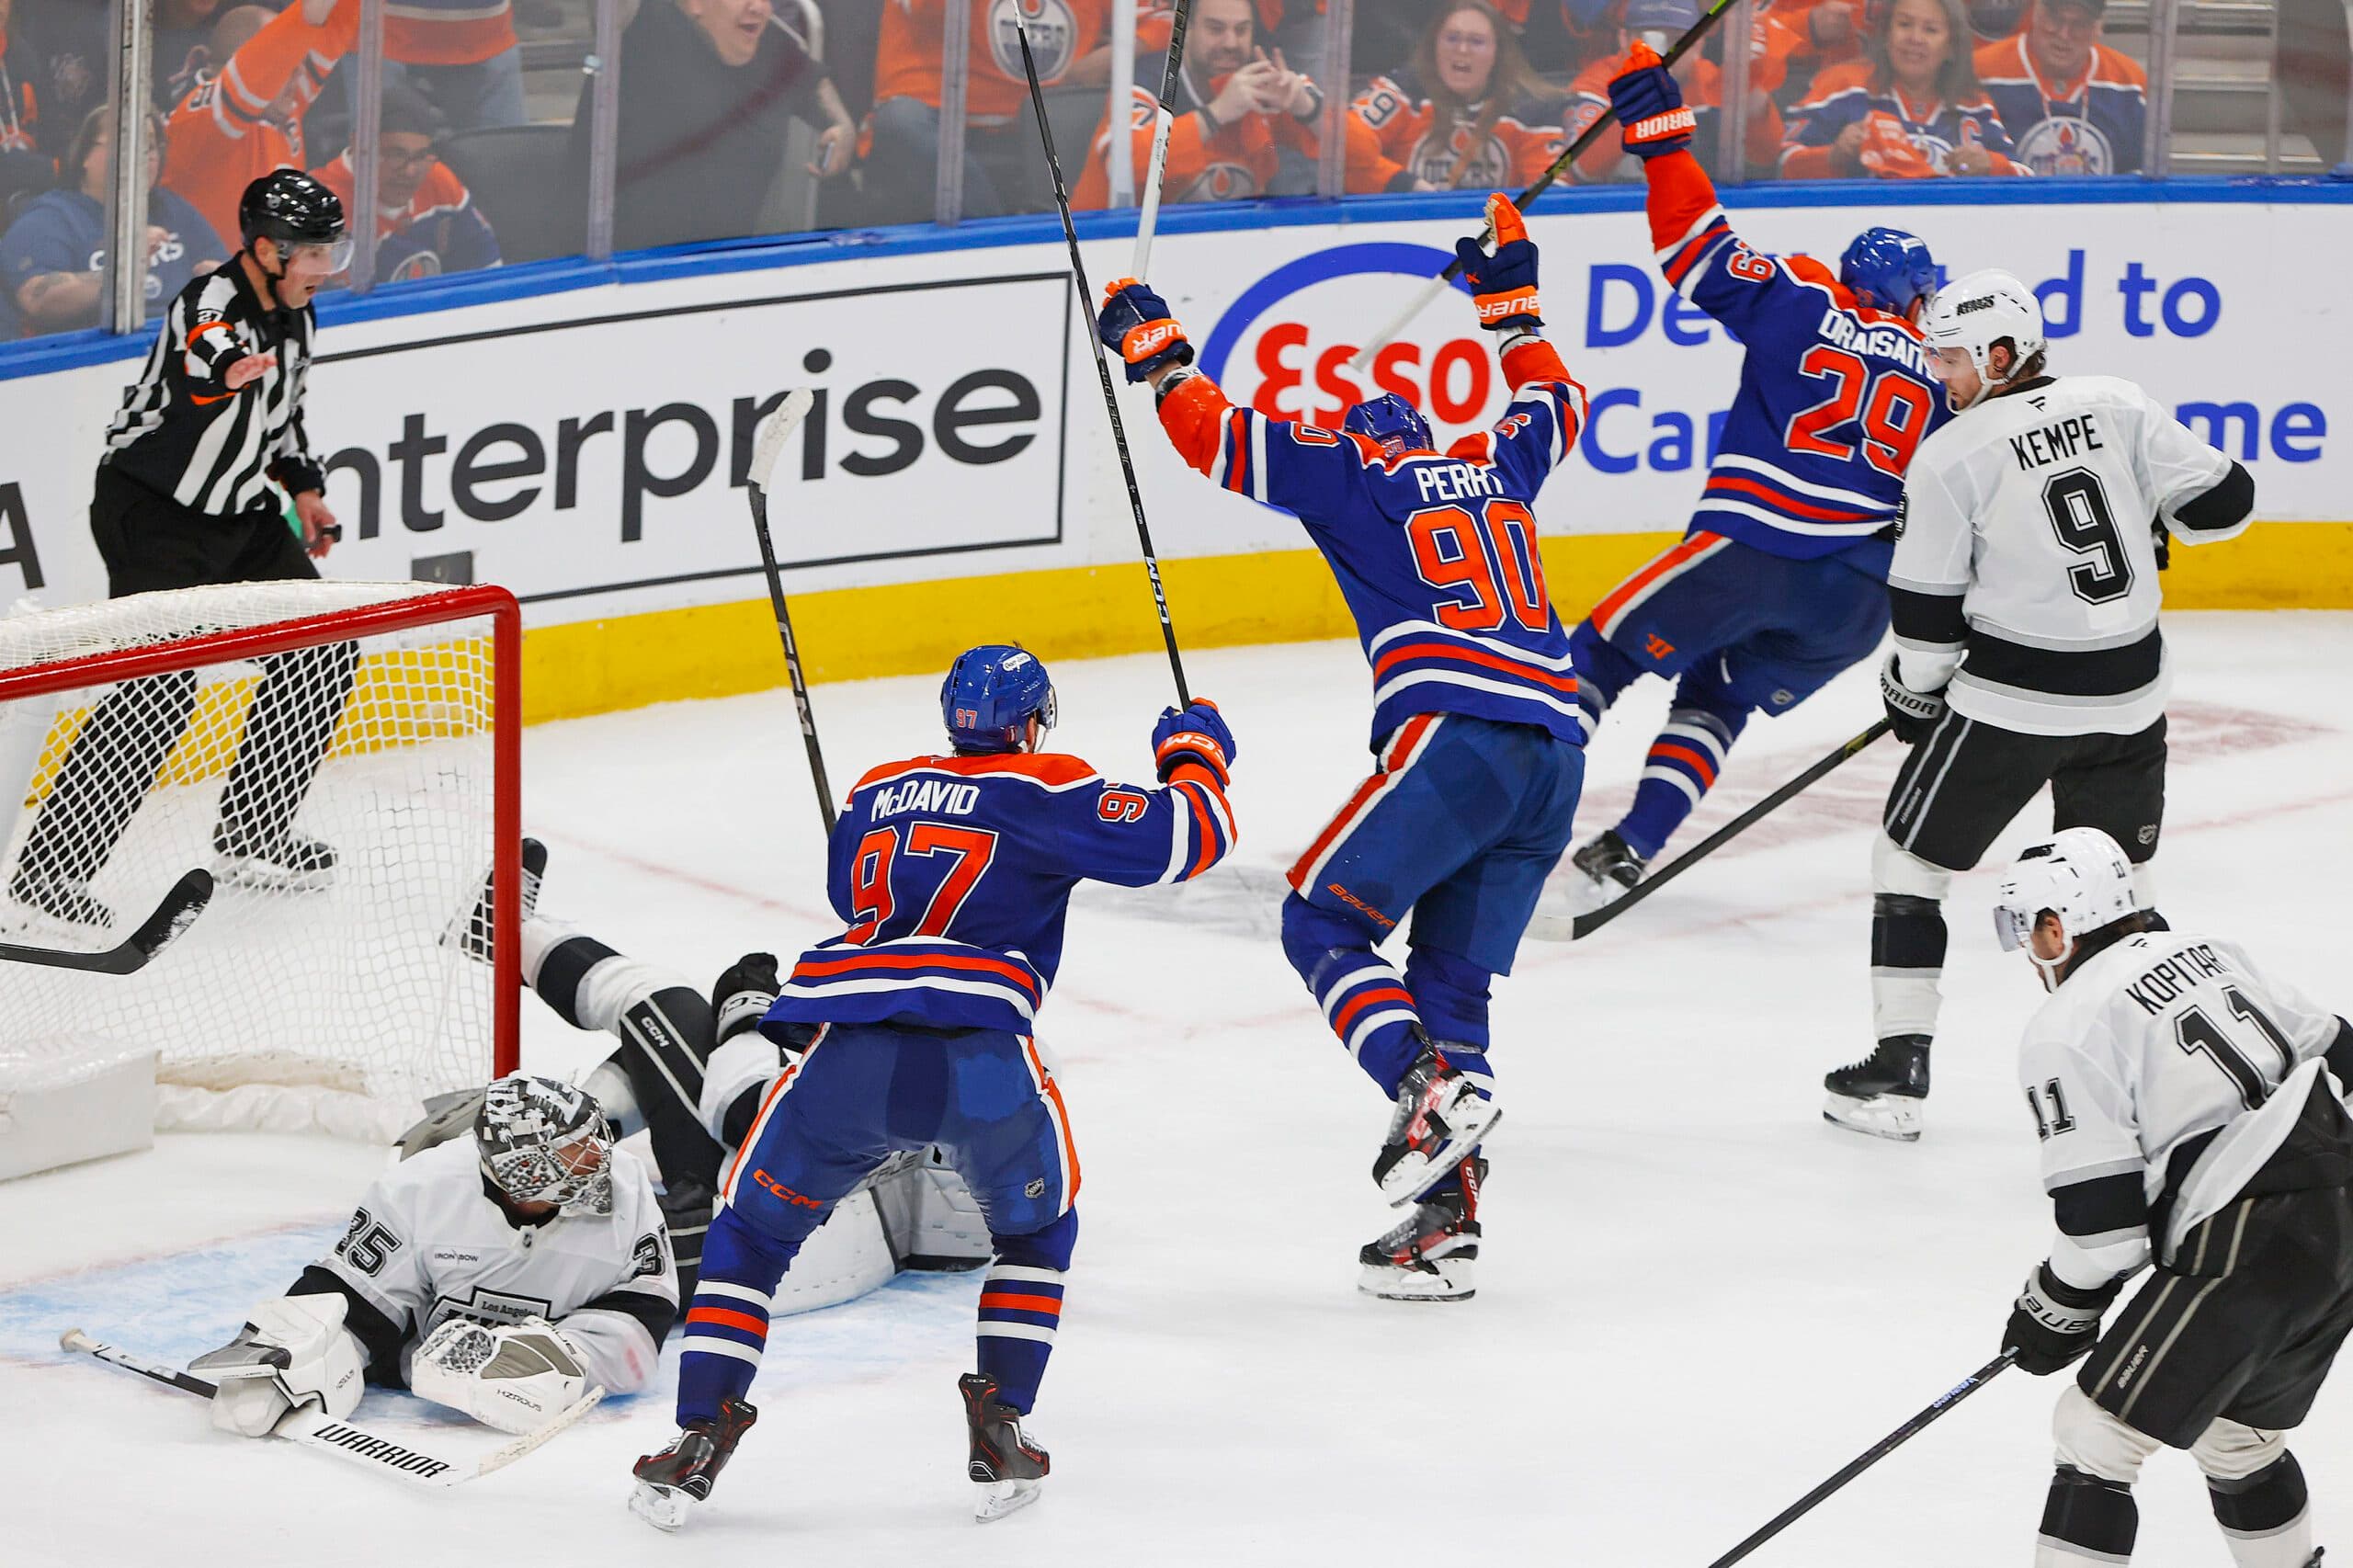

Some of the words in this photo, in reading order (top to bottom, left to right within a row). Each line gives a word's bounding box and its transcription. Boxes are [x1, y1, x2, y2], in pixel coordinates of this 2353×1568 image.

[2118, 261, 2222, 338] to
[1253, 322, 1491, 430] Esso
[1783, 344, 1936, 480] 29
[322, 348, 1041, 543] nterprise
[2009, 414, 2103, 471] KEMPE
[1404, 497, 1551, 633] 90
[2040, 466, 2136, 607] 9
[1145, 555, 1171, 625] CCM
[956, 708, 978, 730] 97
[870, 779, 981, 823] McDAVID
[843, 821, 1000, 948] 97
[2125, 944, 2234, 1016] KOPITAR
[641, 1016, 670, 1048] CCM
[2174, 984, 2296, 1112] 11
[753, 1169, 824, 1210] CCM
[482, 1301, 502, 1312] Los
[313, 1424, 450, 1479] WARRIOR
